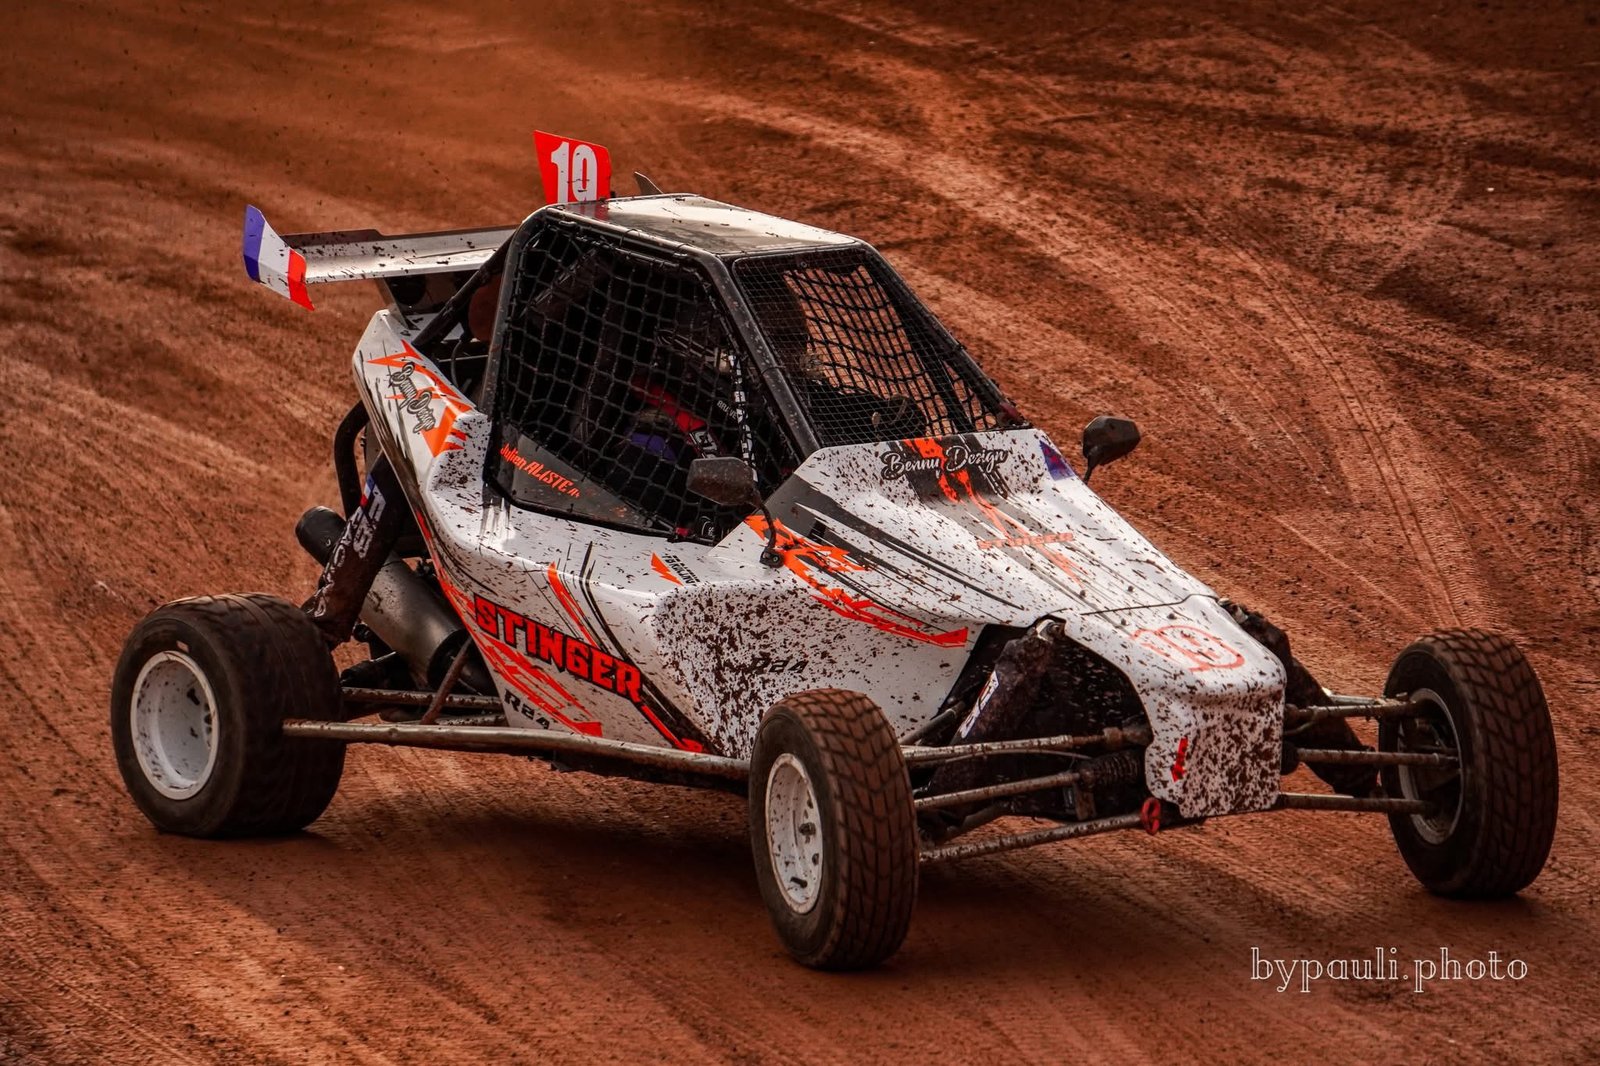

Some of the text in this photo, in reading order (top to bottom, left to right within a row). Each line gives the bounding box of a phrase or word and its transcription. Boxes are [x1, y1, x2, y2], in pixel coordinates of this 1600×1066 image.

[387, 361, 437, 434] Benny Design
[500, 443, 528, 470] Julien
[524, 461, 574, 493] ALISTE
[881, 444, 1007, 480] Benny Design
[474, 593, 643, 704] STINGER
[504, 689, 551, 730] R24
